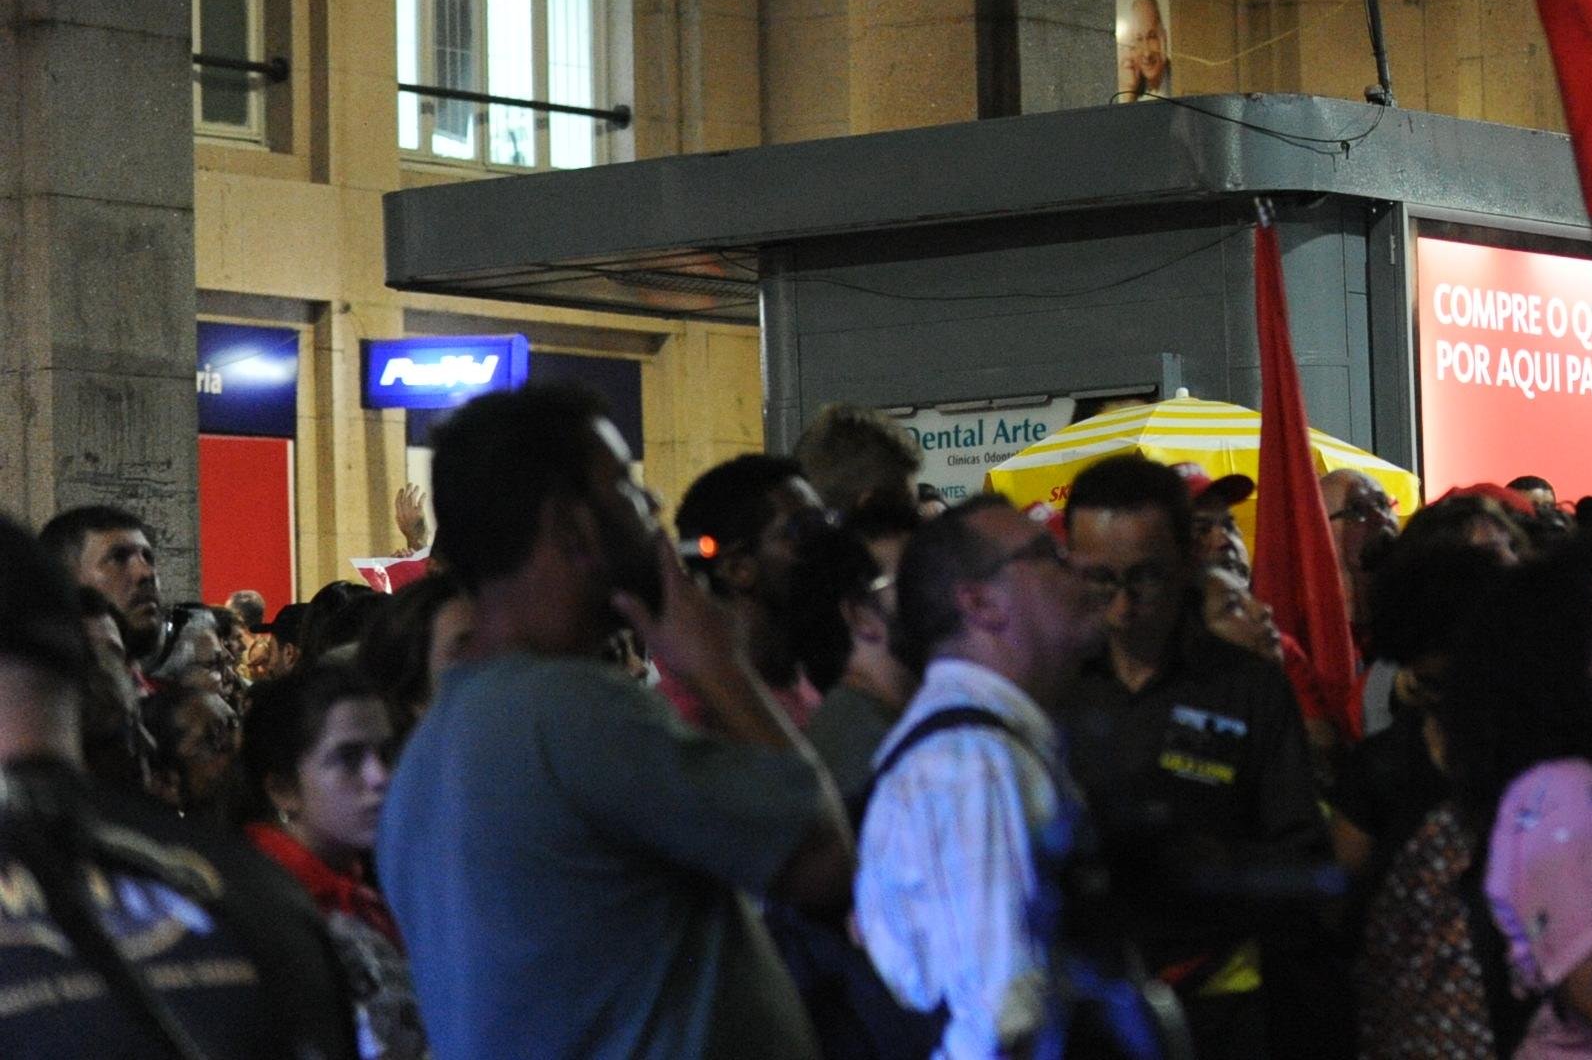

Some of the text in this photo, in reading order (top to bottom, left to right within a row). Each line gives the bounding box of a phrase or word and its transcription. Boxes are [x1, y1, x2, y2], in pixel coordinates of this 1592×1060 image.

[1432, 282, 1543, 336] COMPRE
[1546, 297, 1568, 338] O
[1435, 339, 1492, 386] POR
[1496, 346, 1561, 400] AQUI
[992, 418, 1047, 444] Arte
[1049, 483, 1071, 502] SK
